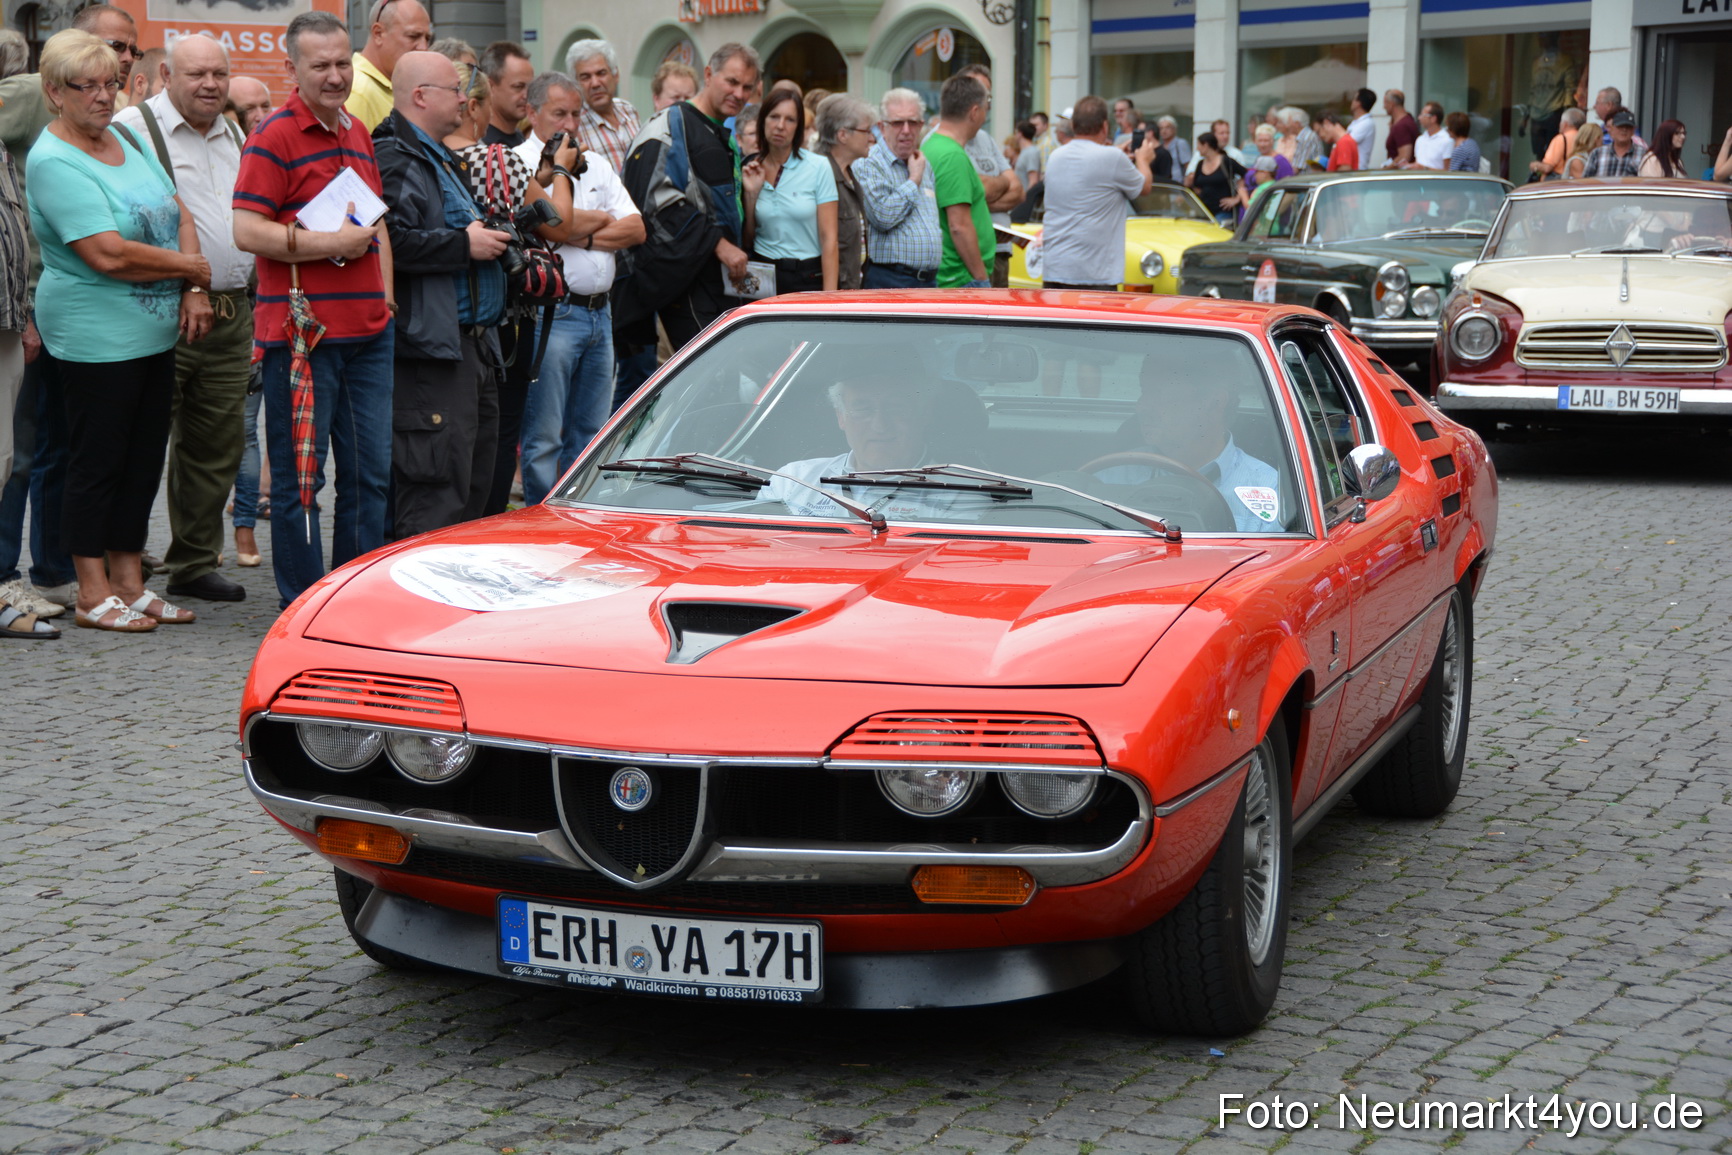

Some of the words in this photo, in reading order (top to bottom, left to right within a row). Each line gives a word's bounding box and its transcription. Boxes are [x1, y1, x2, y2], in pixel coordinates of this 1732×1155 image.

[1570, 389, 1604, 407] LAU
[1617, 390, 1640, 408] BW
[1644, 391, 1679, 410] 59H
[1251, 503, 1275, 511] 30
[579, 562, 645, 573] 27
[510, 936, 521, 951] D
[533, 911, 618, 967] ERH
[651, 923, 709, 975] YA
[724, 929, 812, 981] 17H
[625, 978, 699, 996] Waldkirchen
[719, 987, 803, 1002] 08581/910633
